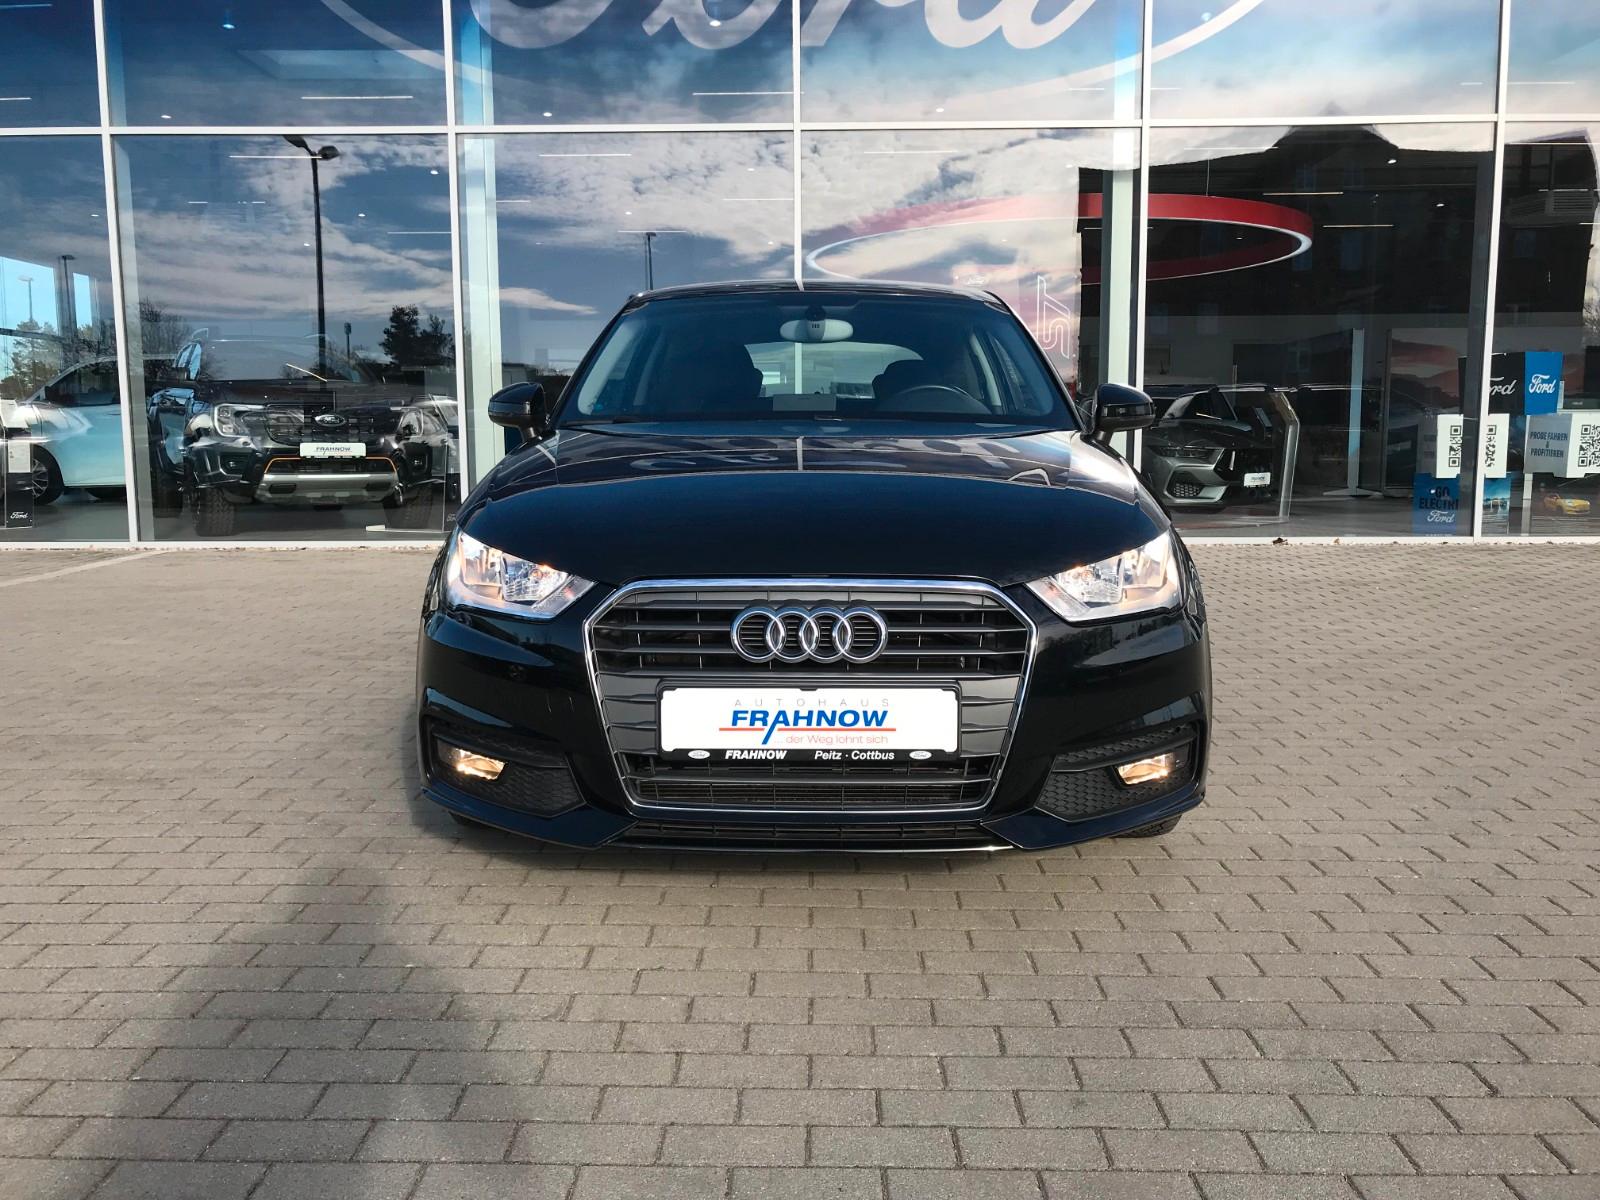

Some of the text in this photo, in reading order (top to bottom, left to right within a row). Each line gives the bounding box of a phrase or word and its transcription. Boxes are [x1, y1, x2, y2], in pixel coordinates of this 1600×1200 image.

[1489, 376, 1518, 396] rd
[1528, 373, 1557, 394] Ford
[1530, 431, 1568, 441] PROBE FAHREN
[316, 446, 351, 455] FRAHNOW
[1530, 448, 1564, 458] PROFITIEREN
[1418, 497, 1460, 510] ELECTRI
[10, 511, 28, 519] Ford
[1427, 510, 1455, 523] Ford
[734, 698, 889, 707] AUTOHAUS
[731, 710, 888, 745] FRAHNOW
[807, 735, 833, 746] Weg
[836, 734, 863, 744] lohnt
[866, 734, 888, 744] sich
[725, 750, 787, 760] FRAHNOW
[814, 750, 895, 760] Peitz Cottbus
